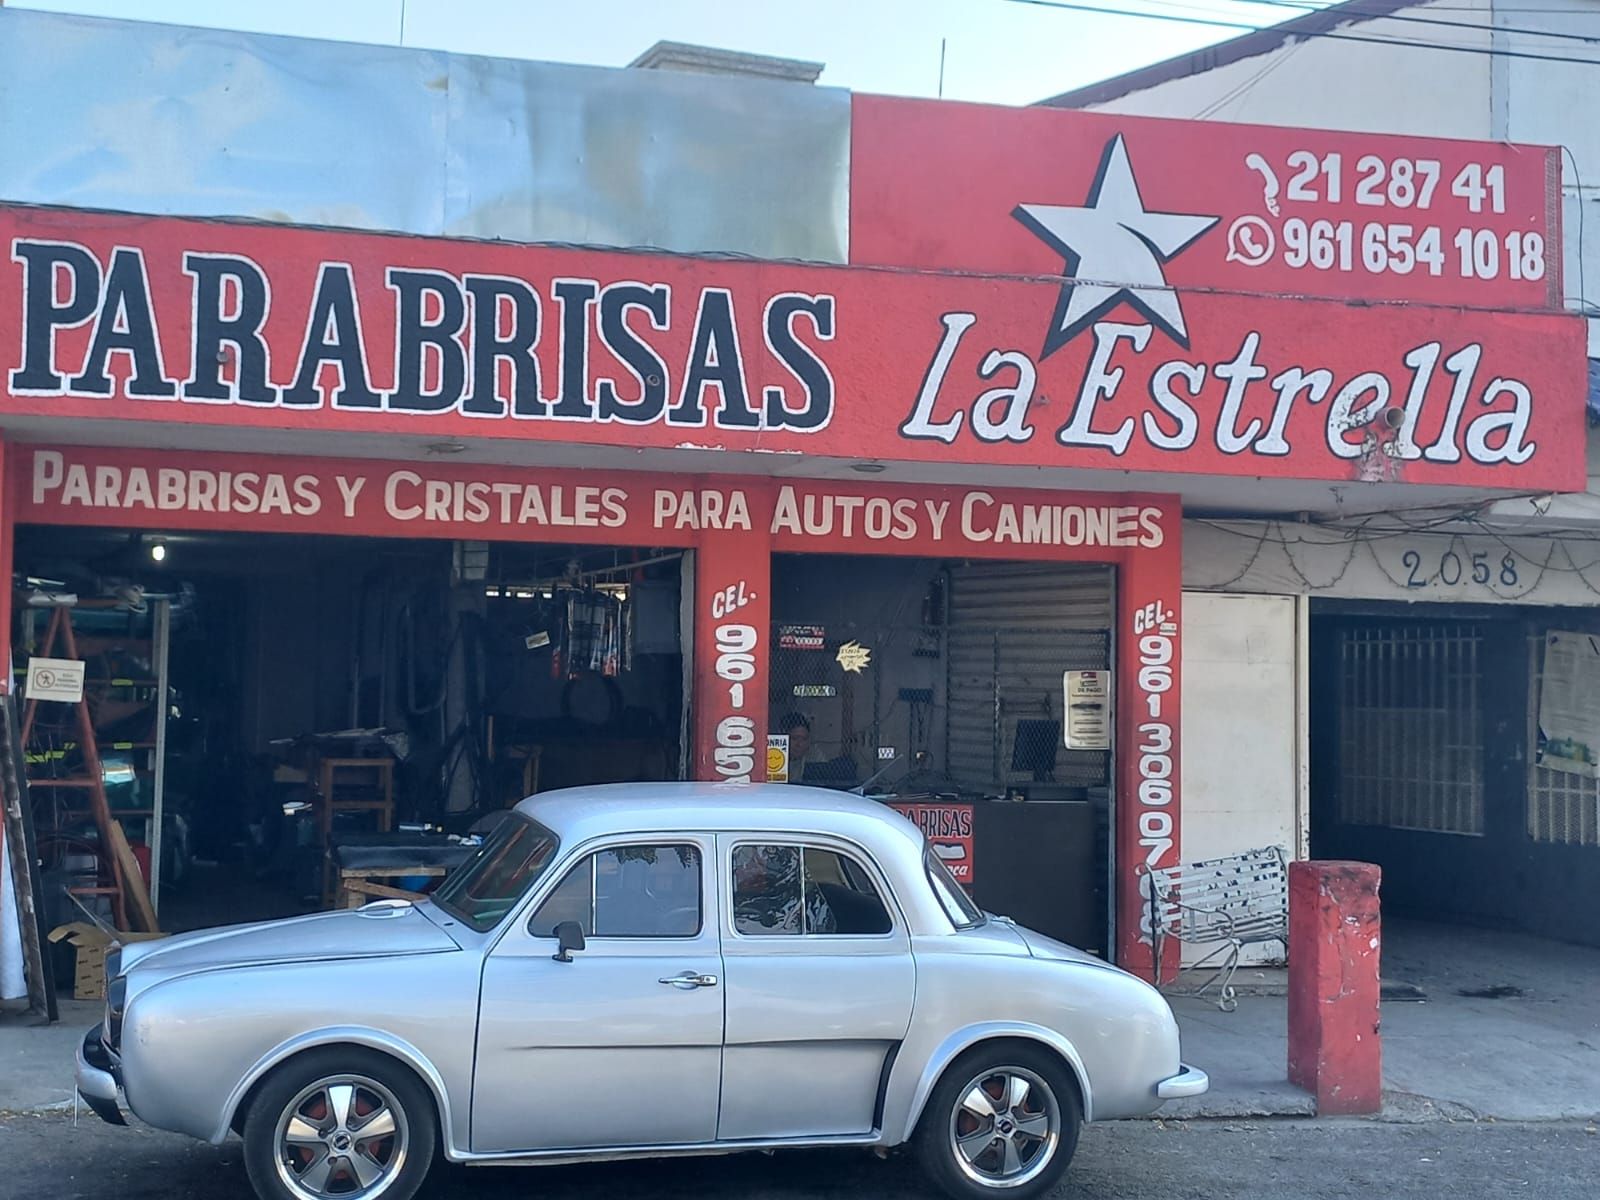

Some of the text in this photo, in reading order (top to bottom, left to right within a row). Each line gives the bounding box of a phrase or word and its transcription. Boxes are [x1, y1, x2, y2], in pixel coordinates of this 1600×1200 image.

[1286, 150, 1506, 214] 21 287 41
[1282, 217, 1546, 282] 961 654 10 18
[6, 236, 837, 434] PARABRISAS
[901, 312, 1535, 464] La Estrella
[32, 450, 1164, 550] PARABRISAS Y CRISTALES PARA AUTOS Y CAMIONES
[712, 580, 757, 620] CEL.
[1134, 600, 1174, 635] CEL.
[713, 623, 758, 784] 961 65
[1138, 634, 1173, 718] 961
[895, 808, 973, 839] ABRISAS
